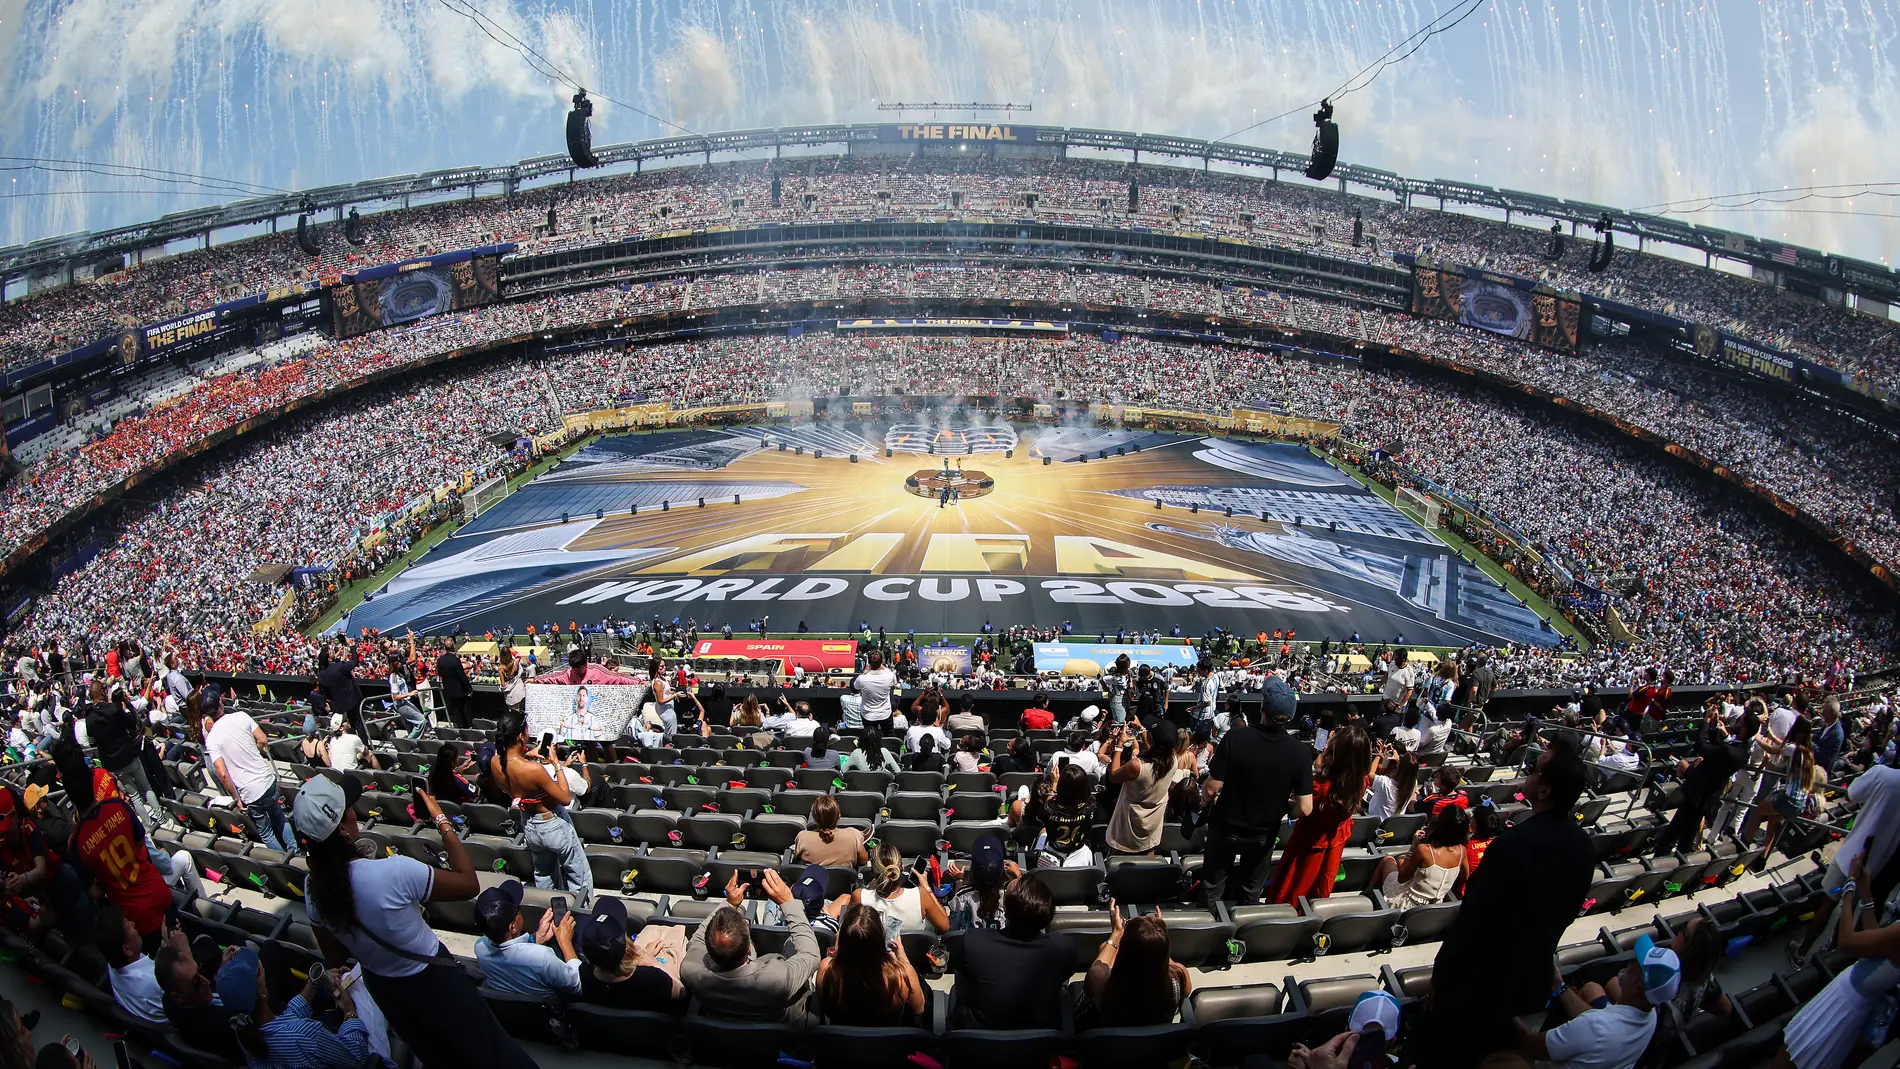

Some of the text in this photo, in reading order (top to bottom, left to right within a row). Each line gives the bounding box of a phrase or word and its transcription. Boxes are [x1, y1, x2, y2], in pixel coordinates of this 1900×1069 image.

[898, 125, 1017, 140] THE FINAL
[147, 311, 216, 337] FIFA WORLD CUP 2026
[148, 319, 217, 350] THE FINAL
[1724, 340, 1793, 369] FIFA WORLD CUP 2026
[1724, 347, 1792, 382] THE FINAL
[627, 533, 1274, 582] FIFA
[555, 578, 849, 605] WORLD
[863, 578, 1026, 602] CUP
[82, 810, 126, 855] LAMINE YAMAL
[99, 834, 139, 889] 19
